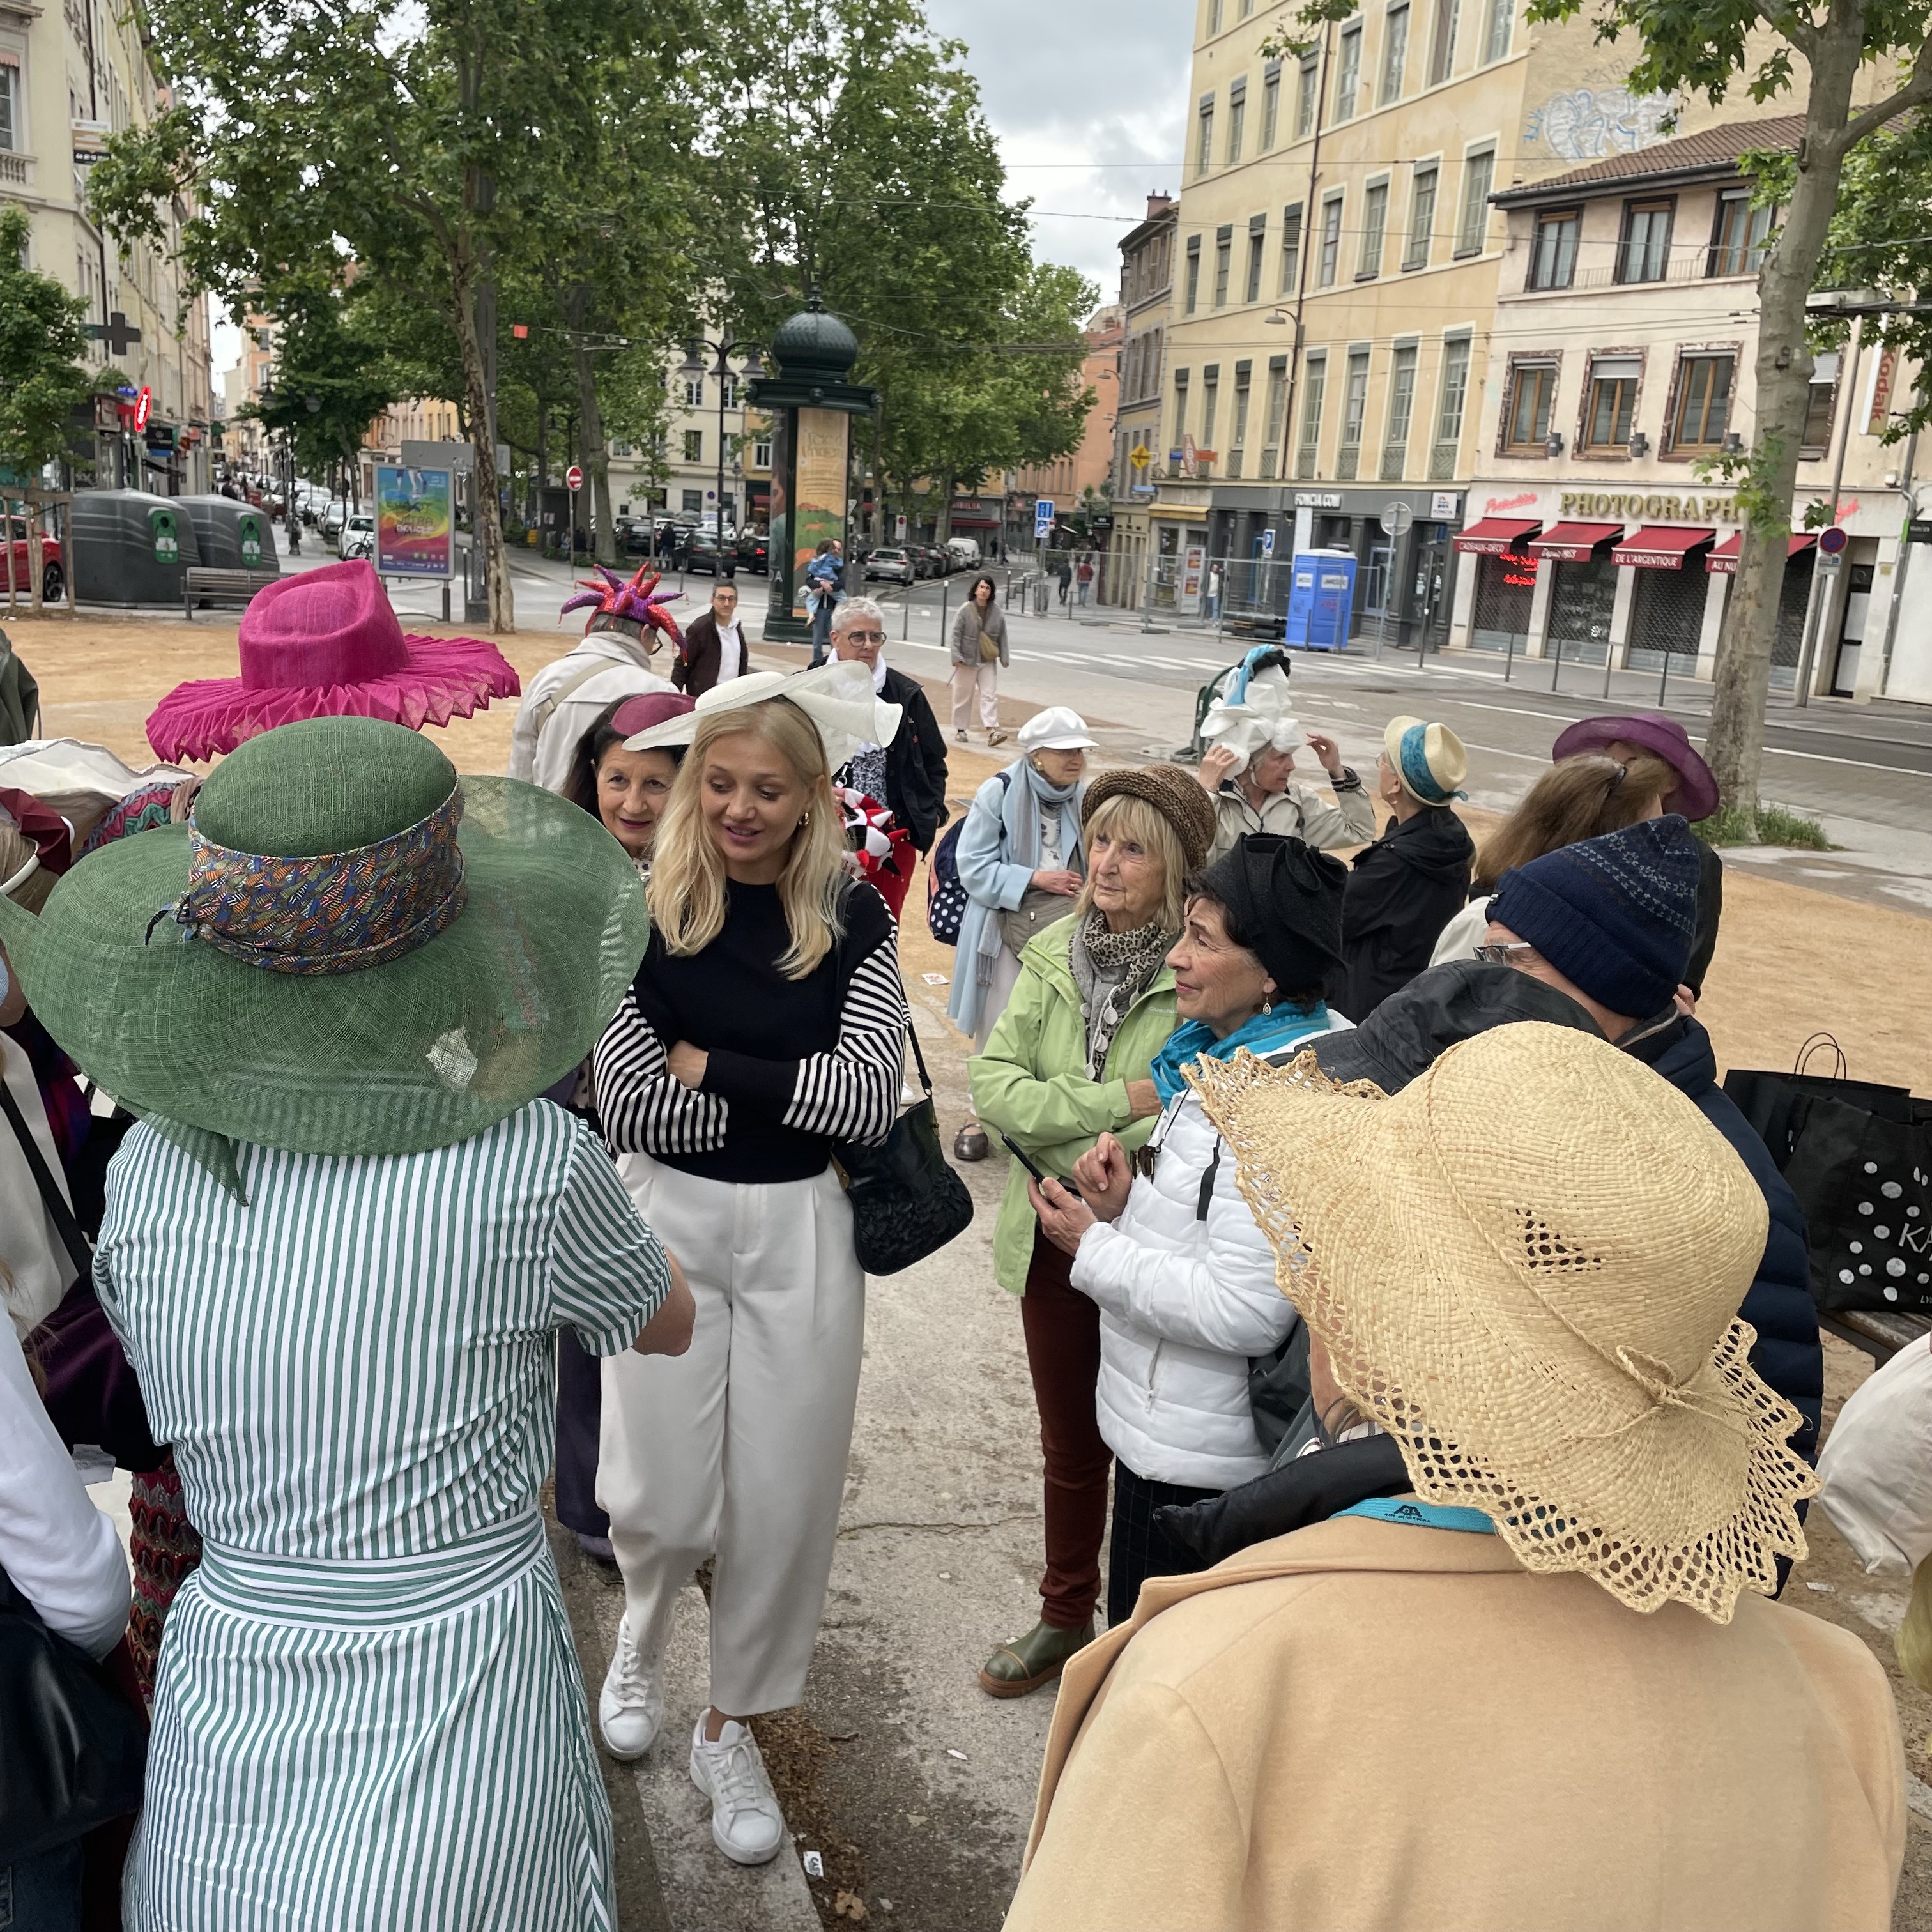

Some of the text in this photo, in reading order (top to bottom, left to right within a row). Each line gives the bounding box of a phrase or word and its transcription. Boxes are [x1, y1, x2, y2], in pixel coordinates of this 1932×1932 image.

[1872, 347, 1896, 420] Kodak
[1615, 553, 1677, 566] DE L'ARGENTIQUE
[1712, 561, 1724, 570] AU
